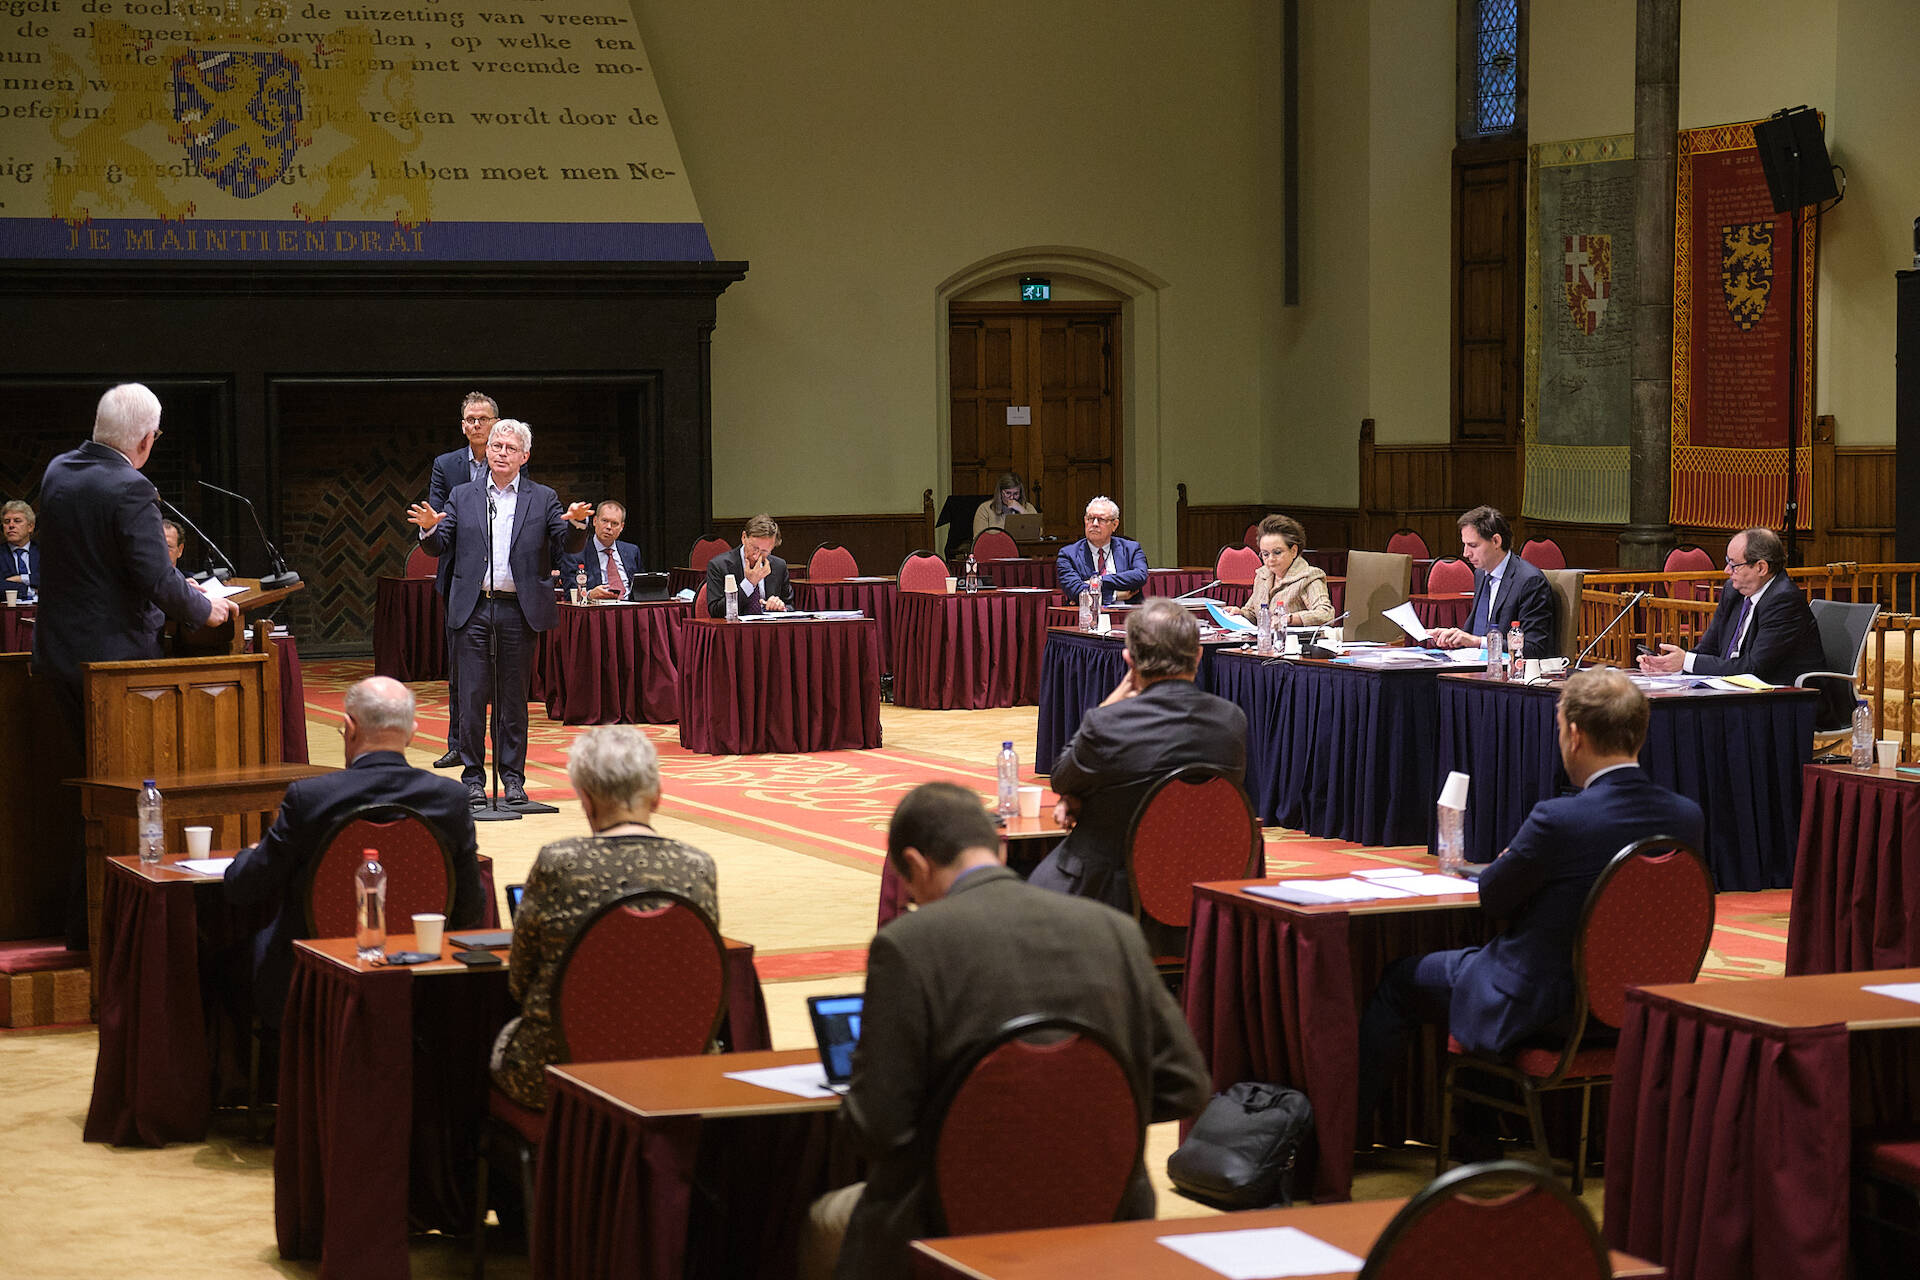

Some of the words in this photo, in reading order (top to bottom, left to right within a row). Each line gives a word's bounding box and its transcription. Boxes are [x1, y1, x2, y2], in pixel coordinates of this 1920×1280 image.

[81, 0, 112, 13] de
[301, 3, 331, 19] de
[344, 5, 465, 28] uitzetting
[479, 12, 525, 24] van
[540, 14, 628, 26] vreem-
[17, 21, 49, 38] de
[451, 36, 482, 53] op
[498, 32, 571, 49] welke
[595, 37, 636, 50] ten
[0, 51, 41, 64] un
[411, 59, 460, 72] met
[472, 57, 580, 74] vreemde
[594, 63, 643, 74] mo-
[471, 107, 551, 126] wordt
[559, 107, 617, 126] door
[628, 108, 660, 126] de
[481, 164, 549, 181] moet
[561, 167, 620, 180] men
[627, 161, 677, 181] Ne-
[65, 228, 111, 251] JE
